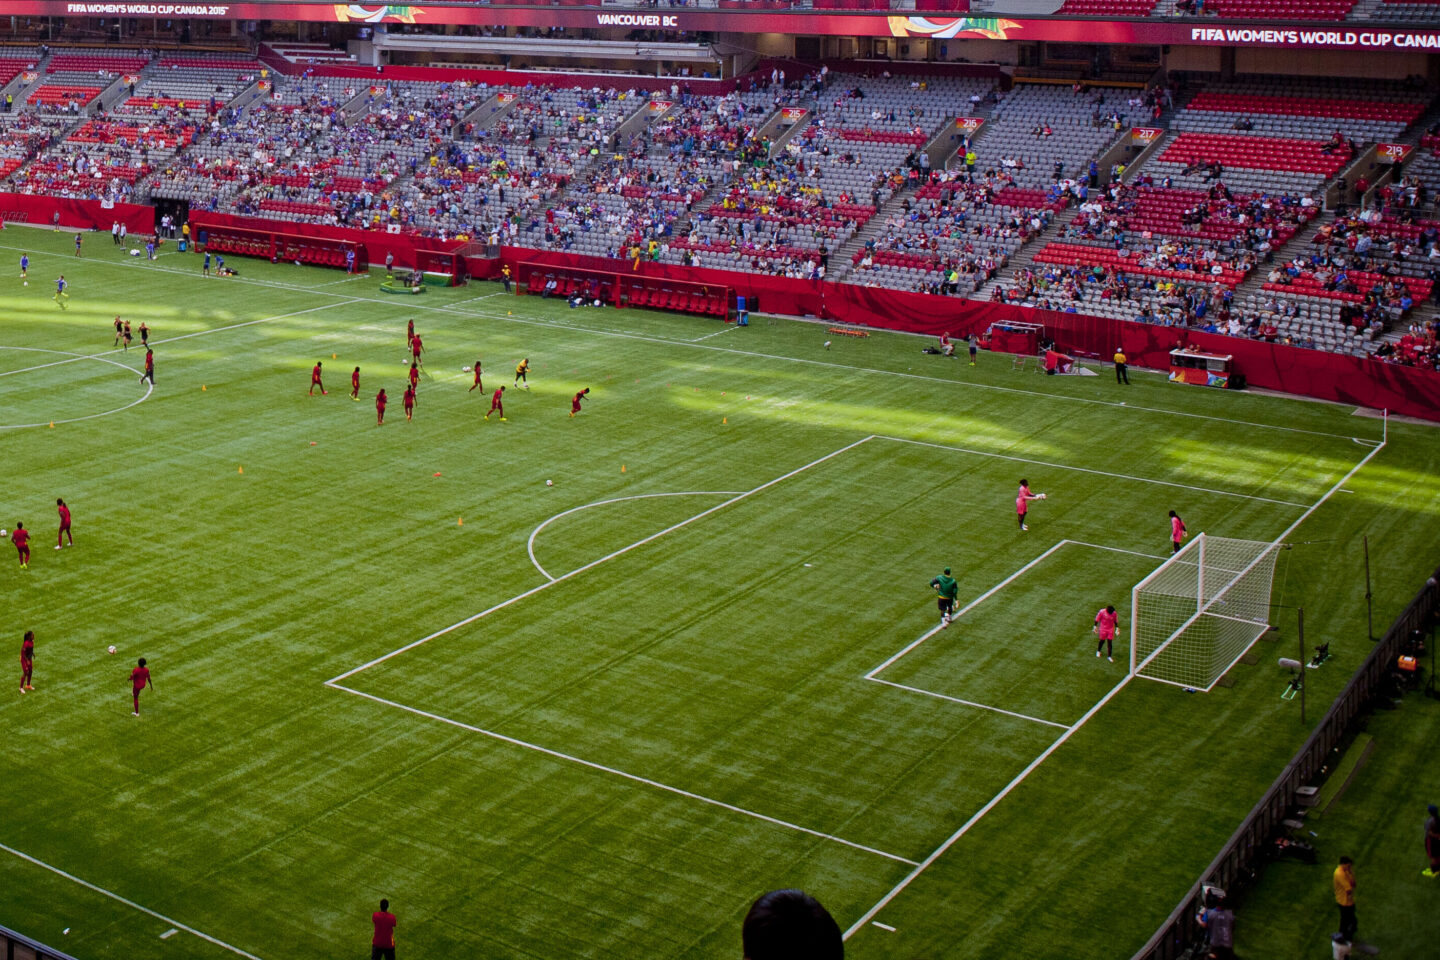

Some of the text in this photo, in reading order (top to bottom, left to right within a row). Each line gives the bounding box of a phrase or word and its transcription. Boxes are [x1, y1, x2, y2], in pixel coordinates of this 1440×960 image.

[68, 4, 86, 12] FIFA
[88, 4, 126, 14] WOMEN'S
[128, 5, 156, 14] WORLD
[158, 6, 174, 14] CUP
[175, 6, 208, 15] CANADA
[597, 14, 678, 26] VANCOUVER BC
[1192, 28, 1225, 40] FIFA
[1226, 30, 1298, 43] WOMEN'S
[1300, 32, 1357, 44] WORLD
[1360, 33, 1392, 46] CUP
[788, 110, 801, 118] 215
[963, 119, 977, 128] 216
[1139, 130, 1154, 138] 217
